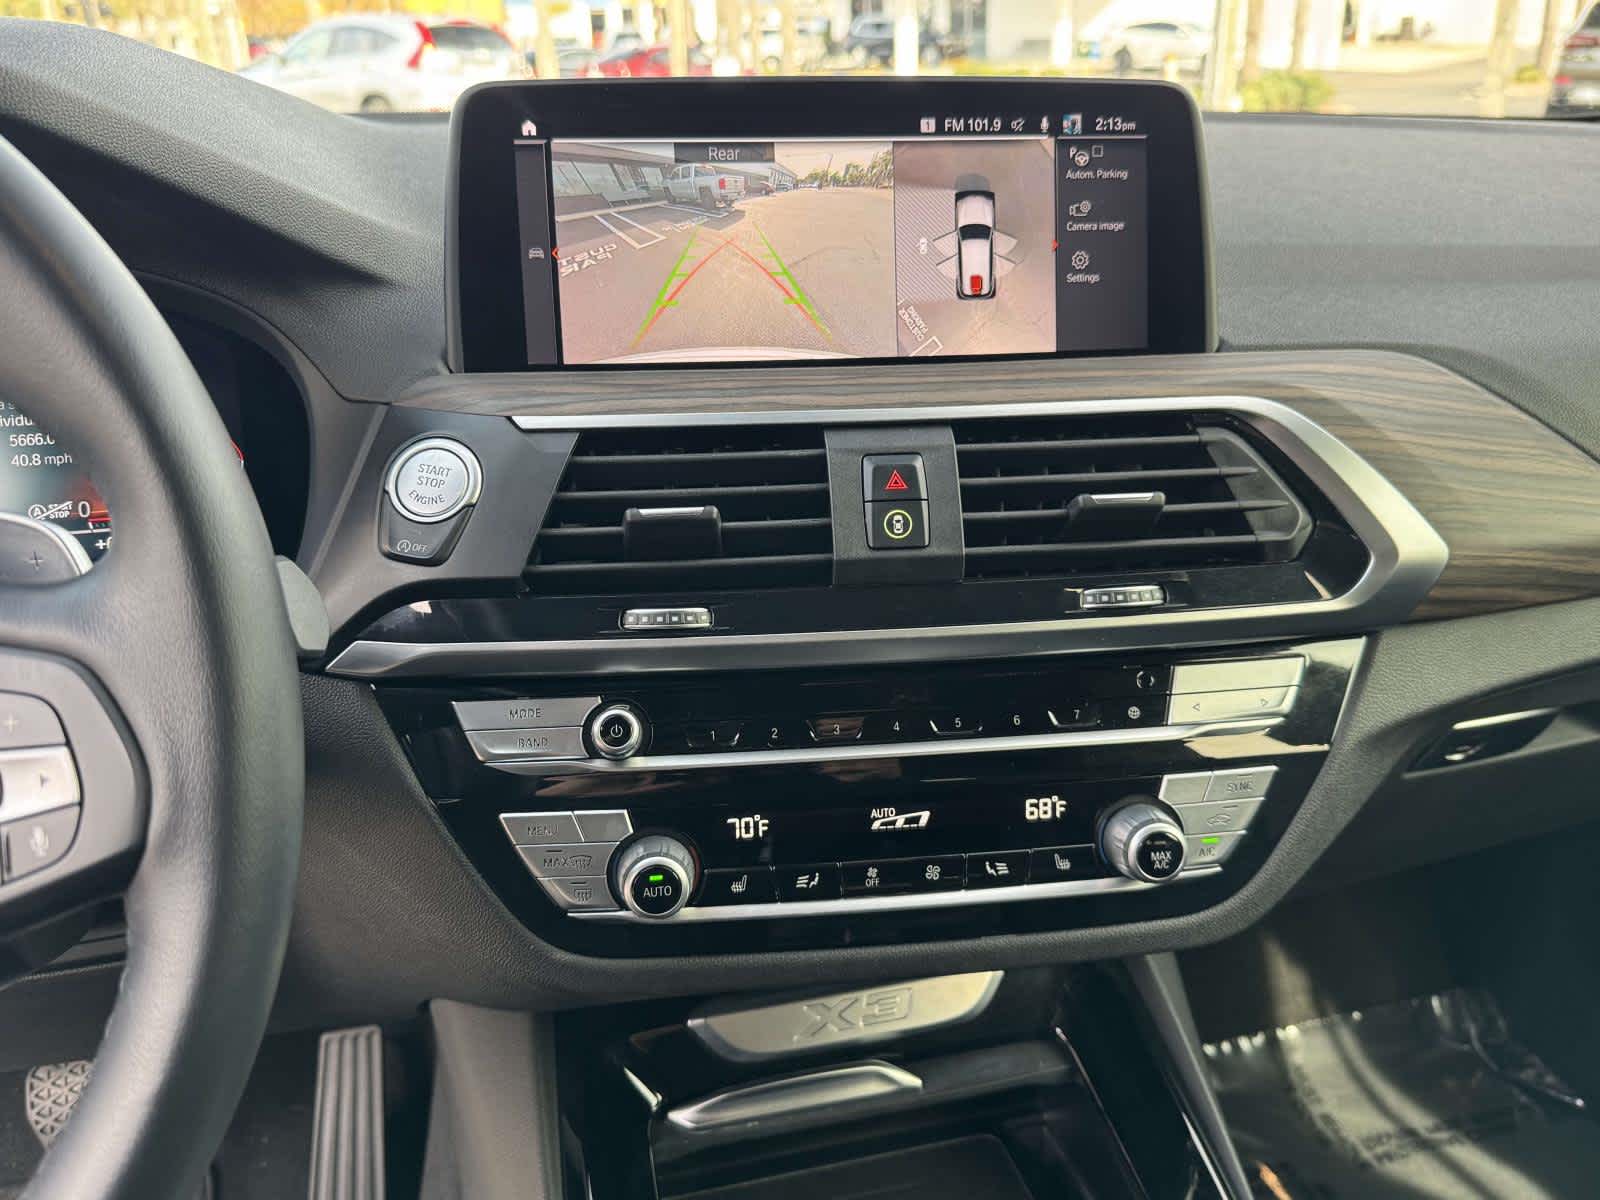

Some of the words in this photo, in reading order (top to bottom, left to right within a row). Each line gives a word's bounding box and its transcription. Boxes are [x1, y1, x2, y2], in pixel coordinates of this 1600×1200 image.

[944, 118, 964, 132] FM
[967, 118, 1001, 132] 101.9
[708, 146, 740, 160] Rear
[1065, 169, 1095, 180] Autom.
[1096, 169, 1128, 182] Parking
[1066, 221, 1097, 232] Camera
[1098, 221, 1125, 233] image
[1066, 272, 1100, 284] Settings
[10, 453, 41, 466] 40.8
[44, 453, 73, 466] mph
[418, 463, 452, 477] START
[417, 475, 446, 489] STOP
[408, 489, 446, 505] ENGINE
[50, 511, 70, 519] STOP
[78, 501, 90, 518] 0
[508, 707, 543, 720] MODE
[1073, 709, 1081, 720] 7
[893, 721, 901, 732] 4
[954, 718, 962, 729] 5
[1013, 715, 1022, 726] 6
[711, 730, 716, 741] 1
[771, 728, 779, 739] 2
[833, 724, 841, 735] 3
[517, 737, 549, 749] BAND
[1226, 781, 1254, 793] SYNC
[870, 807, 897, 819] AUTO
[527, 825, 559, 837] MENU
[1151, 850, 1172, 861] MAX
[1199, 846, 1216, 858] A/C
[543, 856, 569, 868] MAX
[1153, 859, 1170, 870] A/C
[865, 878, 880, 888] OFF
[643, 885, 673, 898] AUTO
[790, 986, 914, 1045] X3
